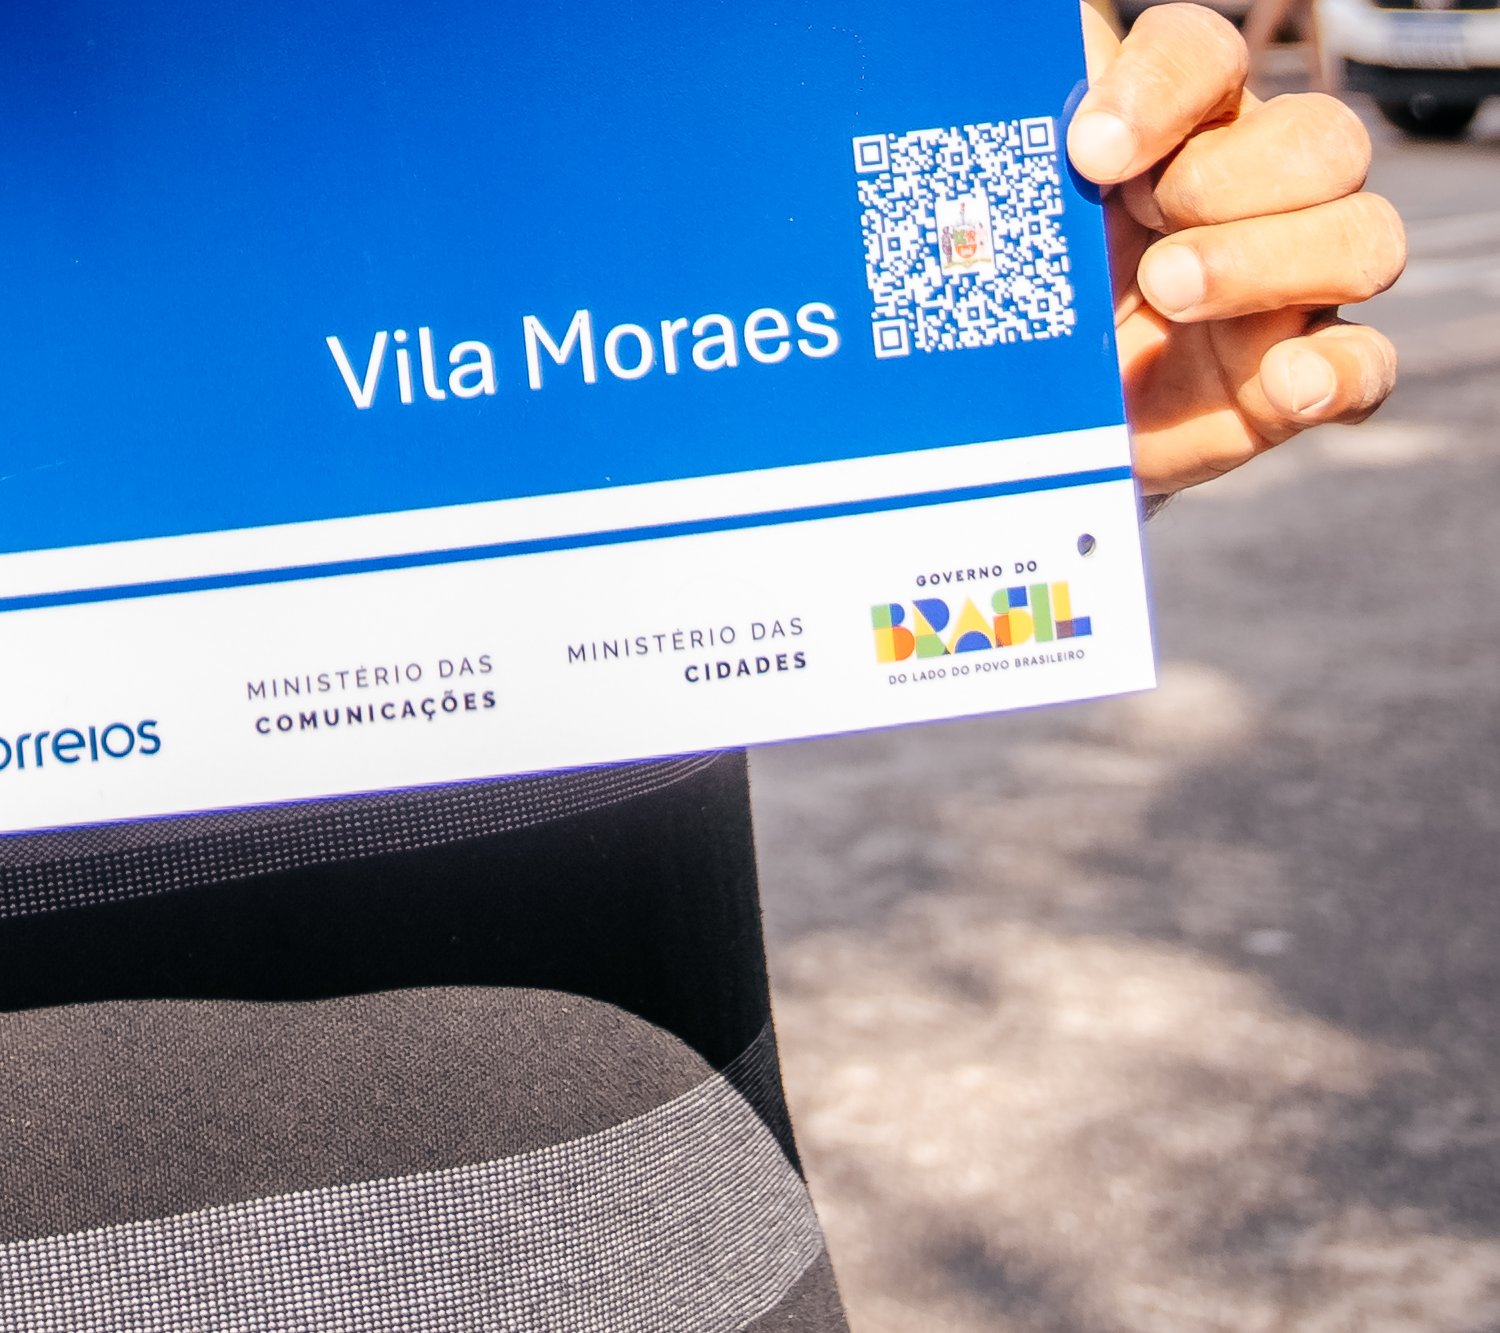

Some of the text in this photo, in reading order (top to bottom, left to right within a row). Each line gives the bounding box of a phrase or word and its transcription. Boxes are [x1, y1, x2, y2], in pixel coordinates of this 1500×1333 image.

[326, 301, 840, 410] Vila Moraes
[916, 560, 1038, 587] GOVERNO DO
[567, 617, 804, 664] MINISTÉRIO DAS
[870, 580, 1093, 664] BRASIL
[246, 654, 493, 700] MINISTÉRIO DAS
[684, 651, 807, 684] CIDADES
[888, 649, 1085, 685] DO LADO DO POVO BRASILEIRO
[254, 689, 497, 735] COMUNICAÇÕES
